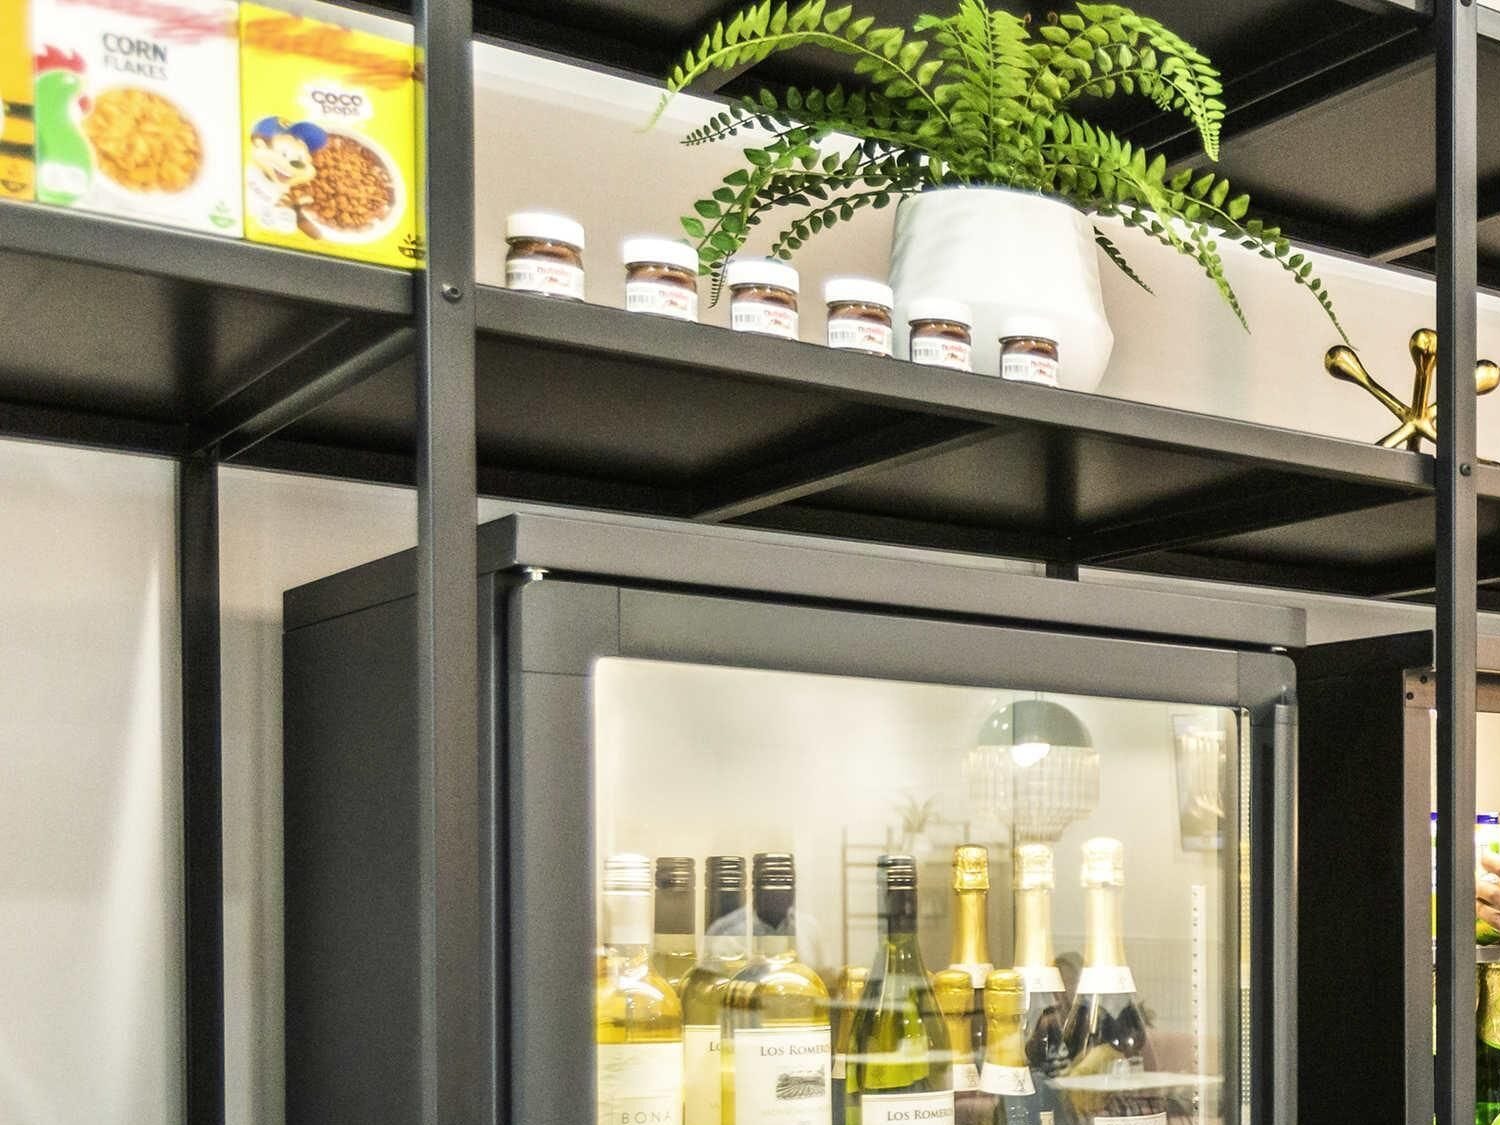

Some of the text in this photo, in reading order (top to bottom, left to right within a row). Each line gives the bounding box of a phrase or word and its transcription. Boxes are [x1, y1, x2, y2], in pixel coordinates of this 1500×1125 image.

[102, 32, 168, 63] CORN
[103, 54, 168, 80] FLAKES
[760, 1045, 785, 1057] LOS
[621, 1111, 672, 1125] BONA
[887, 1110, 910, 1121] LOS
